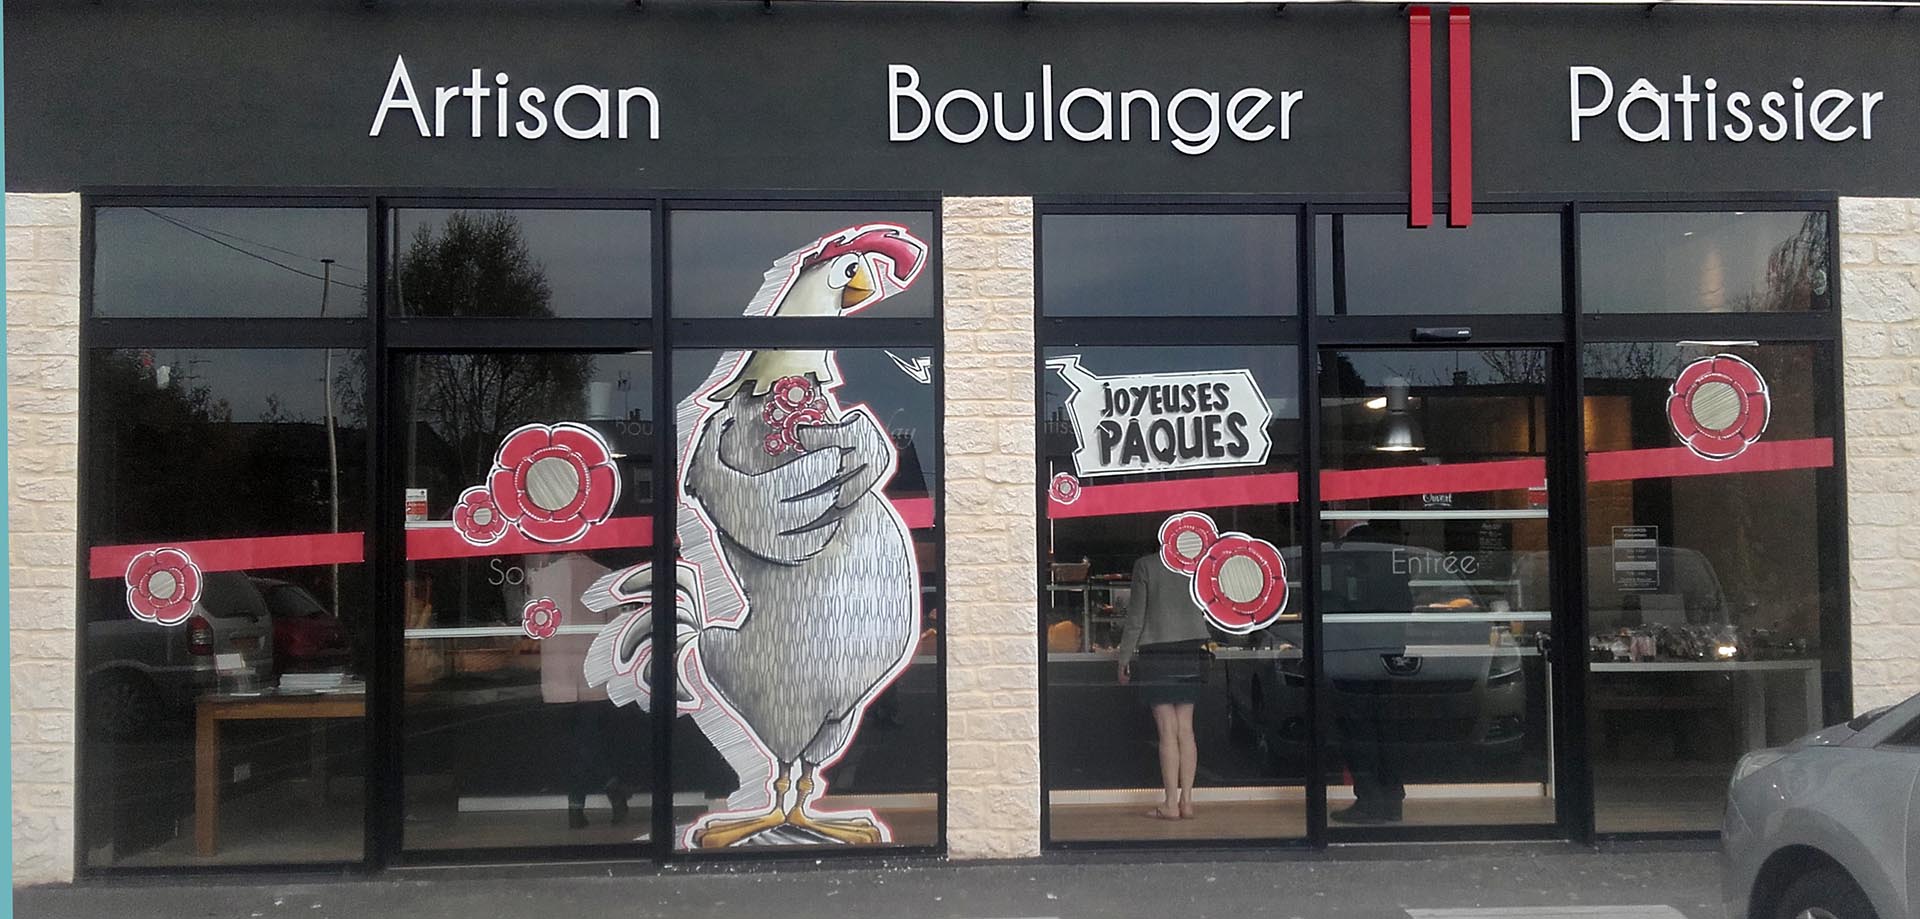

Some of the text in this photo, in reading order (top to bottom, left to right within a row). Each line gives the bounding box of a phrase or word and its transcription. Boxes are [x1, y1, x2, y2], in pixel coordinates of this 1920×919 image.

[369, 54, 1884, 156] Artisan Boulanger Pâtissier
[1391, 547, 1477, 576] Entrée
